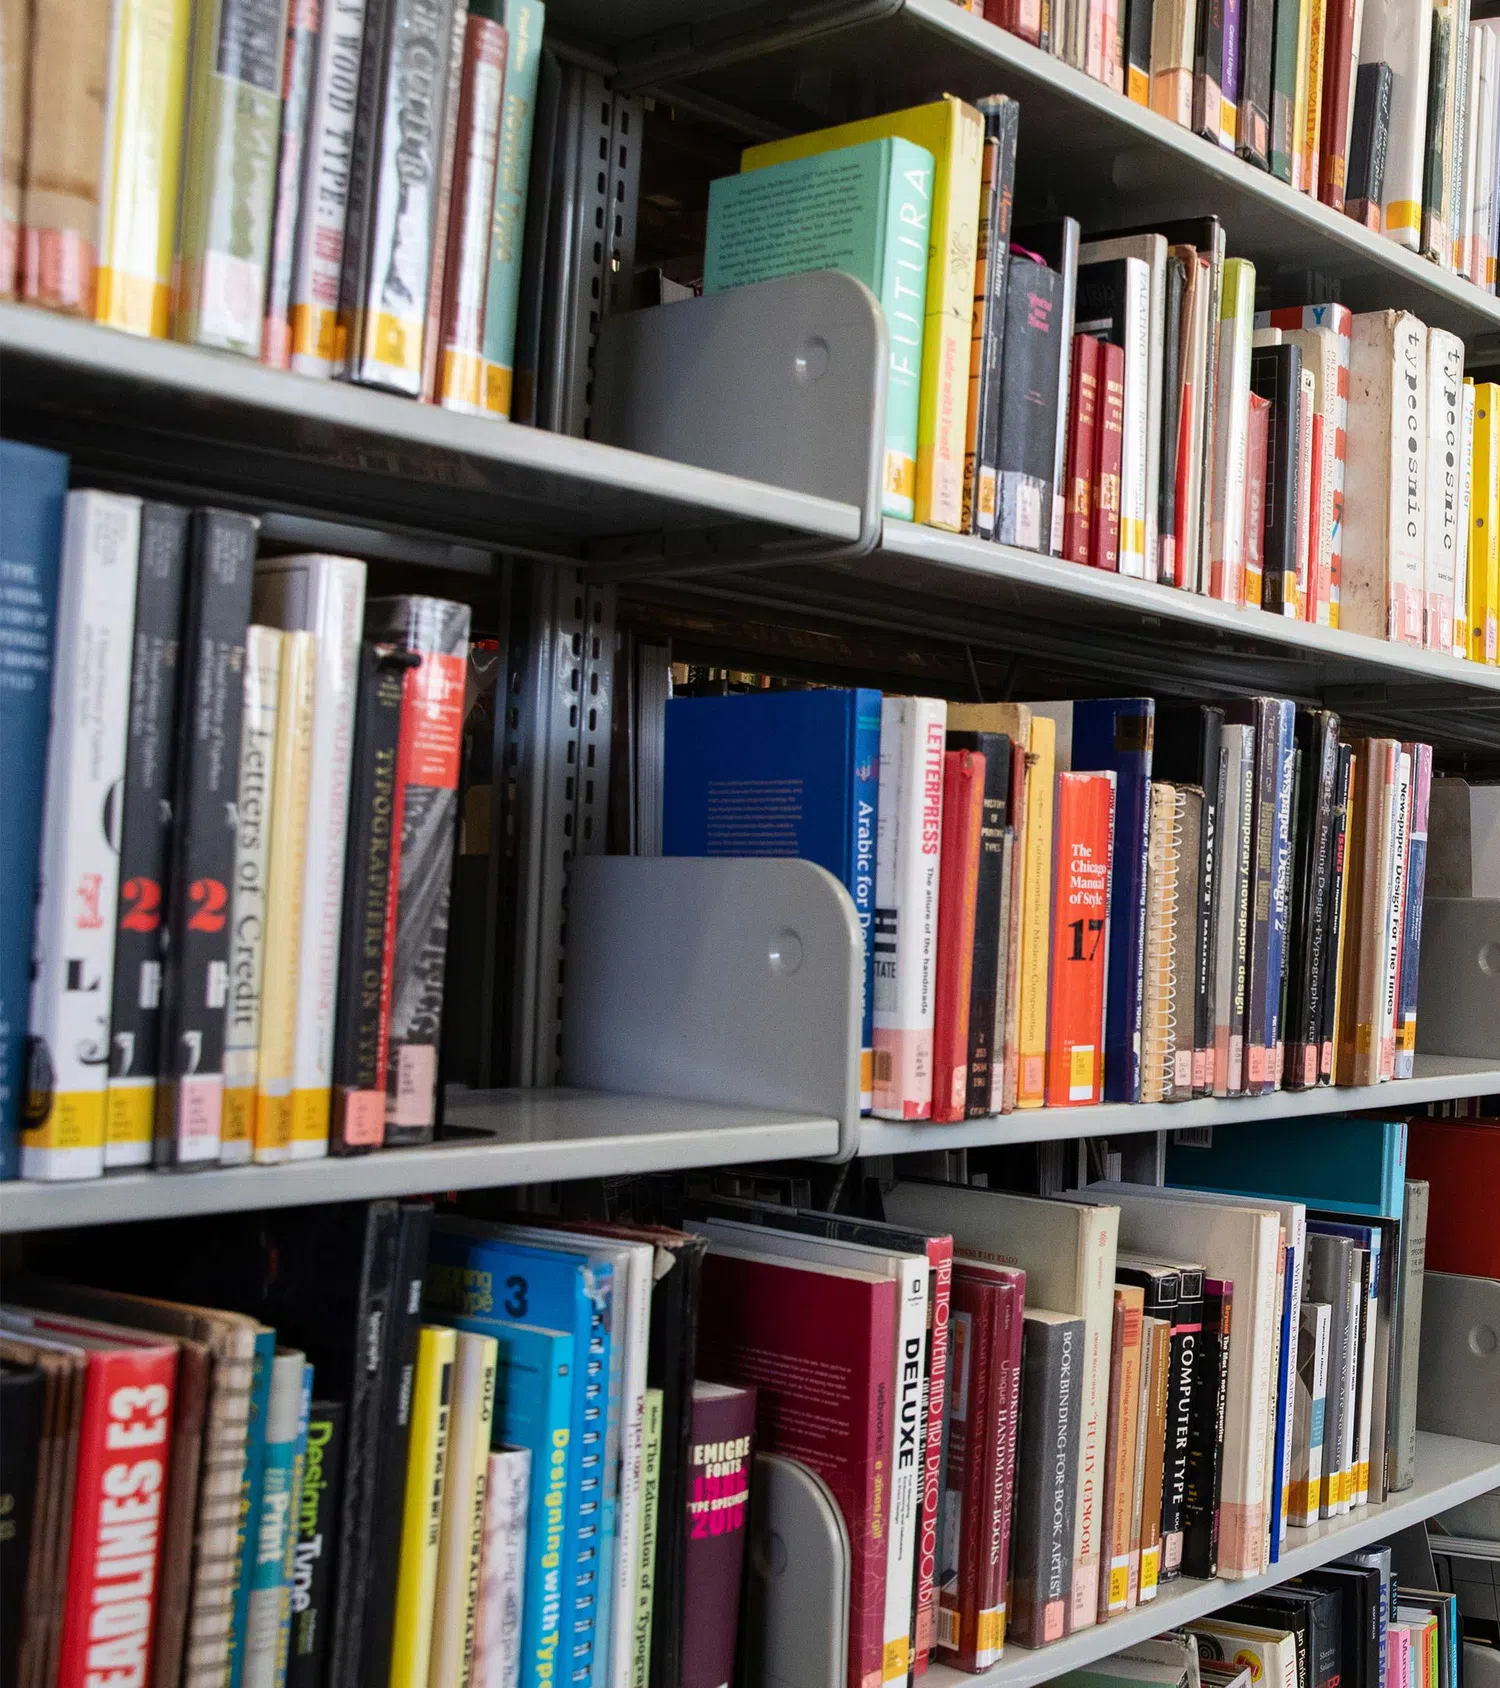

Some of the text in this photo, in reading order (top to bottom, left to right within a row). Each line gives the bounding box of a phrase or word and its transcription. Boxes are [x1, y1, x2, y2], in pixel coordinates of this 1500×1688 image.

[327, 34, 362, 113] WOOD
[495, 203, 521, 262] Type
[889, 169, 930, 377] FUTURA
[1138, 271, 1150, 357] PALATINO
[1328, 351, 1337, 414] PRECISION
[1327, 418, 1336, 449] TYPE
[1404, 331, 1421, 538] typecosmic
[1442, 348, 1461, 550] typecosmic
[1325, 490, 1333, 557] REFERENCE
[1266, 742, 1275, 774] BEST
[921, 722, 943, 855] LETTERPRESS
[856, 799, 874, 871] Arabic
[1258, 800, 1276, 873] Newspaper
[1273, 747, 1296, 932] Newspaper Design 2
[1396, 782, 1408, 860] Newspaper
[1070, 859, 1107, 875] Chicago
[1071, 844, 1092, 857] The
[1137, 779, 1152, 976] Chronology of Typesetting Developments
[1314, 825, 1329, 923] Printing Design
[120, 877, 162, 934] 2
[188, 878, 229, 934] 2
[233, 731, 272, 1028] Letters of Credit
[856, 875, 872, 908] for
[1069, 890, 1103, 906] of Style
[1070, 875, 1105, 890] Manual
[1200, 804, 1215, 995] LAYOUT BALLINGER
[1234, 769, 1254, 1015] contemporary newspaper design
[1256, 879, 1271, 921] Design
[1393, 864, 1404, 914] Design
[358, 749, 395, 1084] TYPOGRAPHERS ON TYPE
[921, 866, 935, 1015] The allure of the handmade
[1028, 836, 1045, 1042] Fundamentals of Modern Composition
[1067, 918, 1106, 961] 17
[1391, 918, 1401, 941] For
[1390, 945, 1398, 967] The
[1386, 974, 1397, 1016] Times
[504, 1274, 529, 1318] 3
[1264, 1261, 1274, 1314] GRAPHIC
[1291, 1263, 1301, 1302] Writing
[1223, 1304, 1231, 1335] Beyond
[1261, 1317, 1271, 1363] DESIGN
[1342, 1324, 1350, 1360] When
[1221, 1370, 1228, 1378] is
[1259, 1366, 1269, 1391] FOR
[1289, 1325, 1297, 1378] JOURNAL
[1340, 1365, 1347, 1382] We
[1352, 1356, 1357, 1365] OF
[481, 1366, 494, 1422] SOLO
[898, 1336, 922, 1470] DELUXE
[924, 1257, 952, 1513] ART NOUVEAU AND ART DECO
[1122, 1360, 1133, 1405] Publishing
[108, 1384, 169, 1450] E3
[1051, 1330, 1072, 1537] BOOKBINDING FOR BOOK
[1120, 1417, 1129, 1448] Artistic
[1122, 1408, 1128, 1416] as
[1172, 1334, 1195, 1505] COMPUTER TYPE
[1218, 1402, 1226, 1443] typewriter
[1338, 1413, 1344, 1431] No
[693, 1435, 750, 1466] EMIGRE
[705, 1458, 742, 1479] FONTS
[990, 1359, 1010, 1566] Unique HANDMADE BOOKS
[1003, 1366, 1021, 1539] BOOKBINDING BASICS
[1119, 1448, 1127, 1483] Practice
[471, 1474, 486, 1557] CIRCUS
[542, 1427, 570, 1569] Designing
[640, 1439, 659, 1606] The Education of a
[1116, 1507, 1124, 1541] Annette
[543, 1569, 560, 1631] with
[1296, 1628, 1305, 1647] Jan
